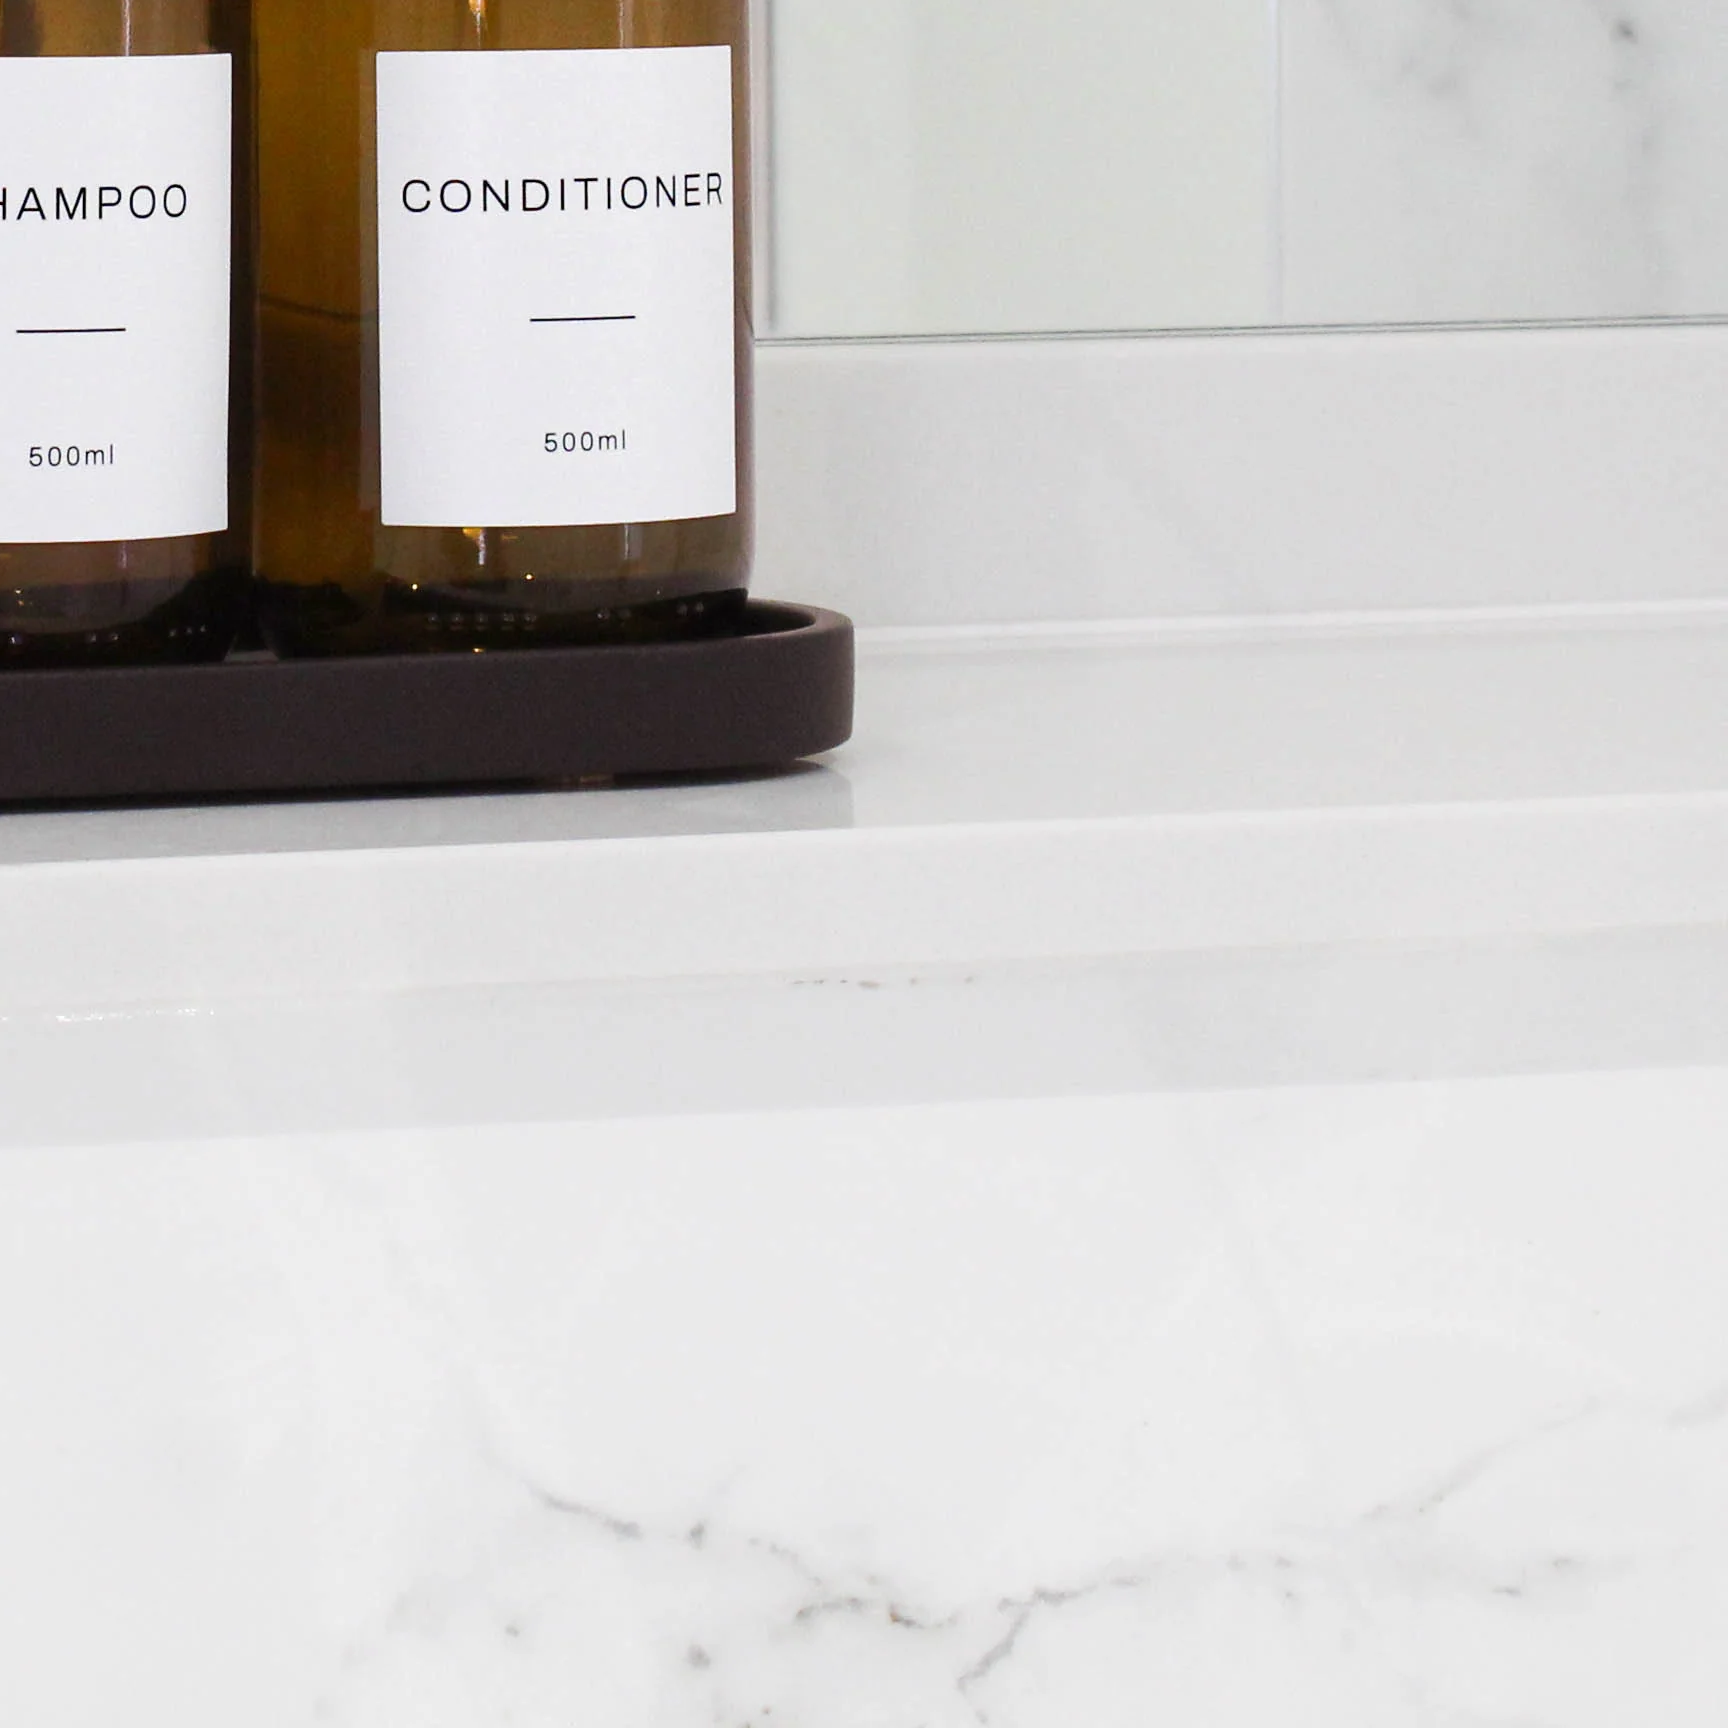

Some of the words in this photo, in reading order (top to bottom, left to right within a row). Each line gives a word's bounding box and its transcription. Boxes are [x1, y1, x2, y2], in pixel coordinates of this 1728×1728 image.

[402, 172, 723, 213] CONDITIONER
[544, 429, 626, 453] 500ml
[29, 444, 114, 467] 500ml
